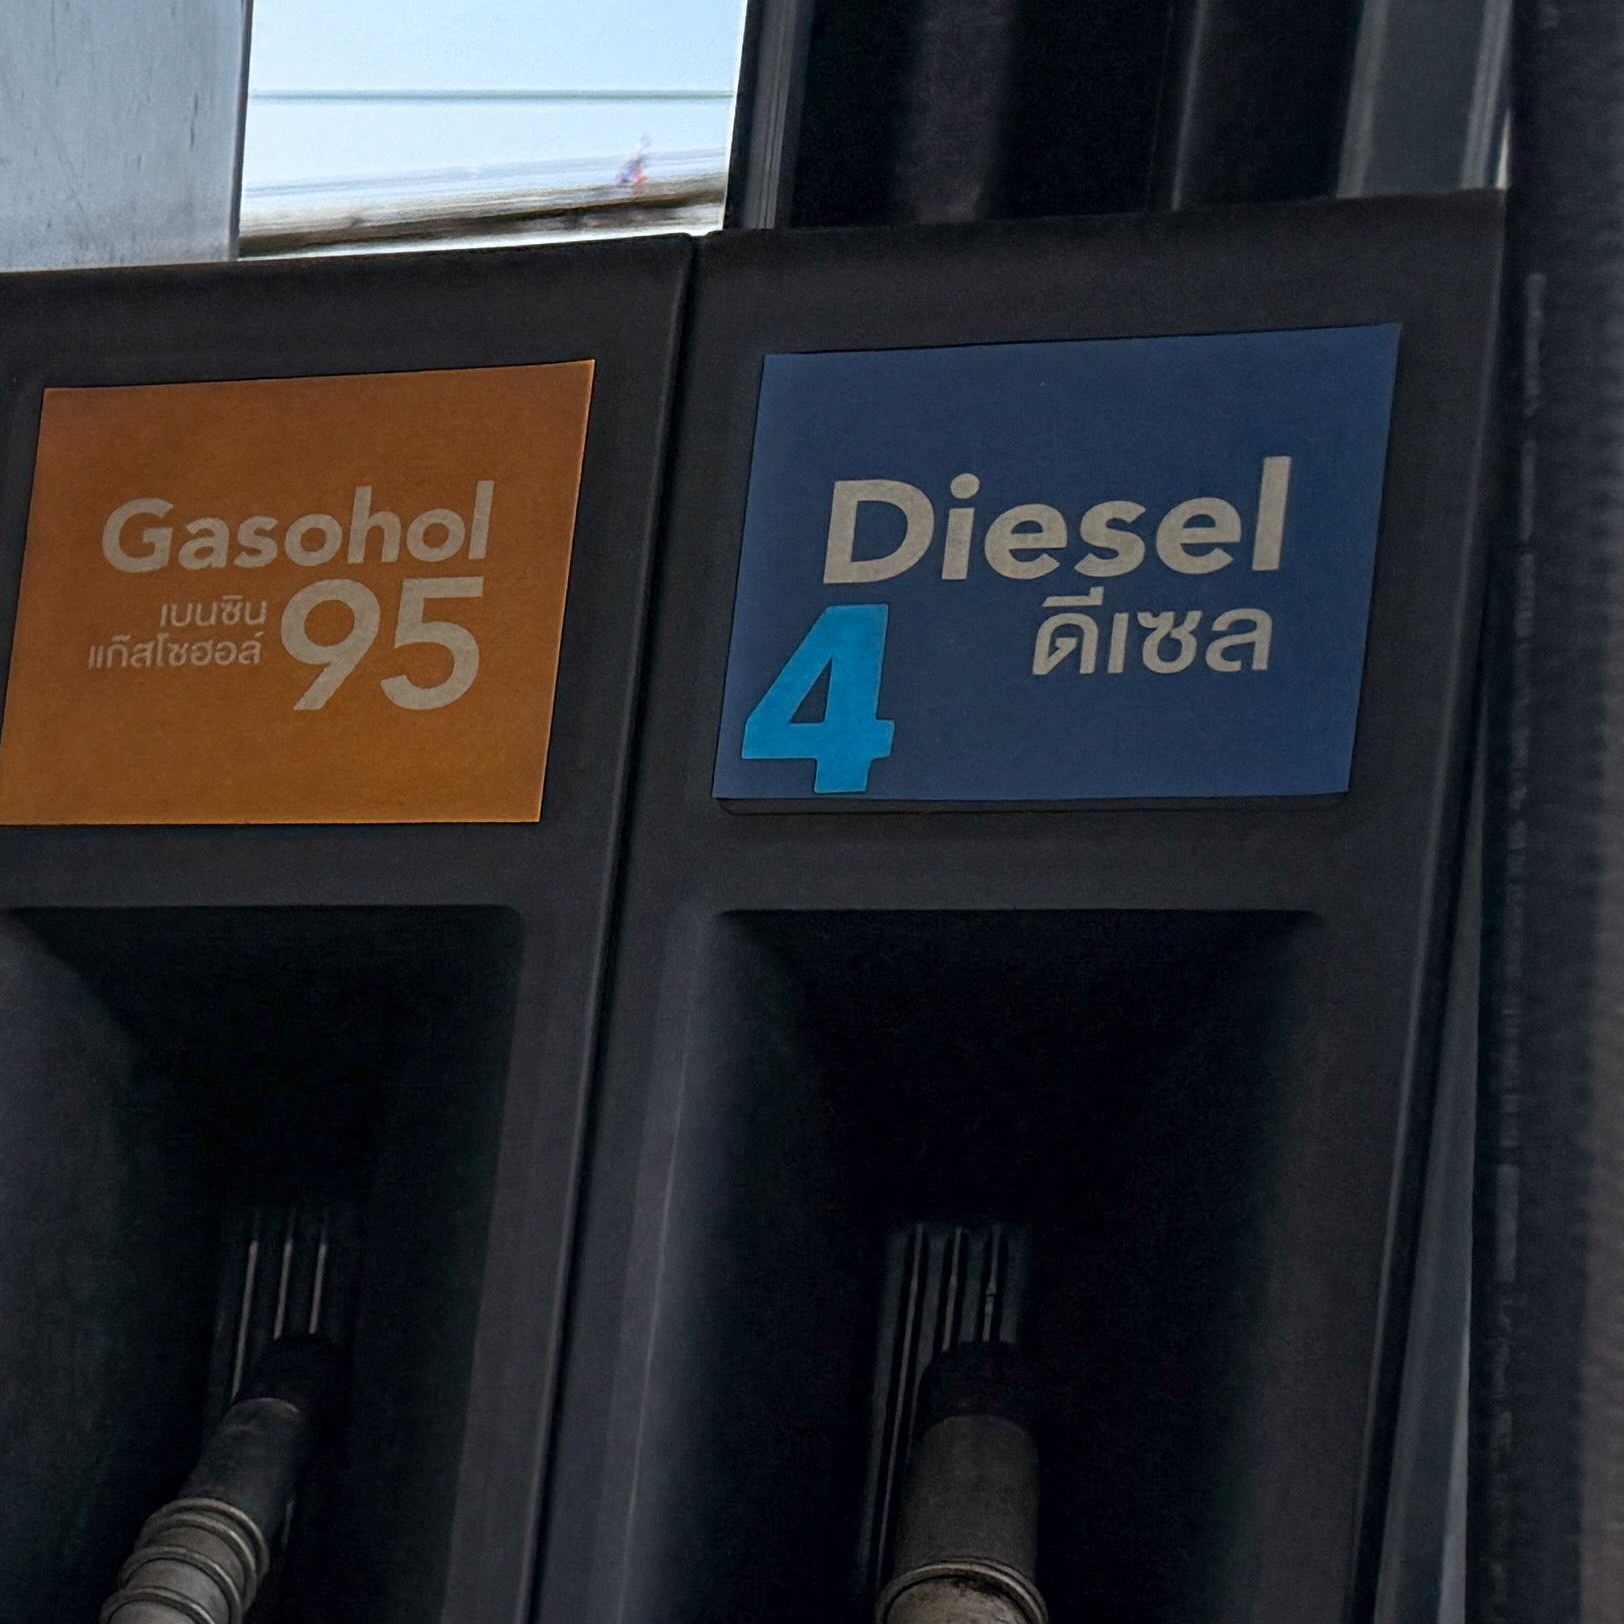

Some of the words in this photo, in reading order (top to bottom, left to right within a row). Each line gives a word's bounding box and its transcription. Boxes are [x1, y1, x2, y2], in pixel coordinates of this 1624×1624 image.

[101, 480, 495, 573] Gasohol
[823, 455, 1292, 585] Diesel
[88, 632, 265, 671] แก๊สโซฮอล์
[159, 594, 267, 629] เบนซิน
[280, 576, 485, 712] 95
[1032, 585, 1273, 676] ดีเซล
[741, 603, 895, 794] 4
